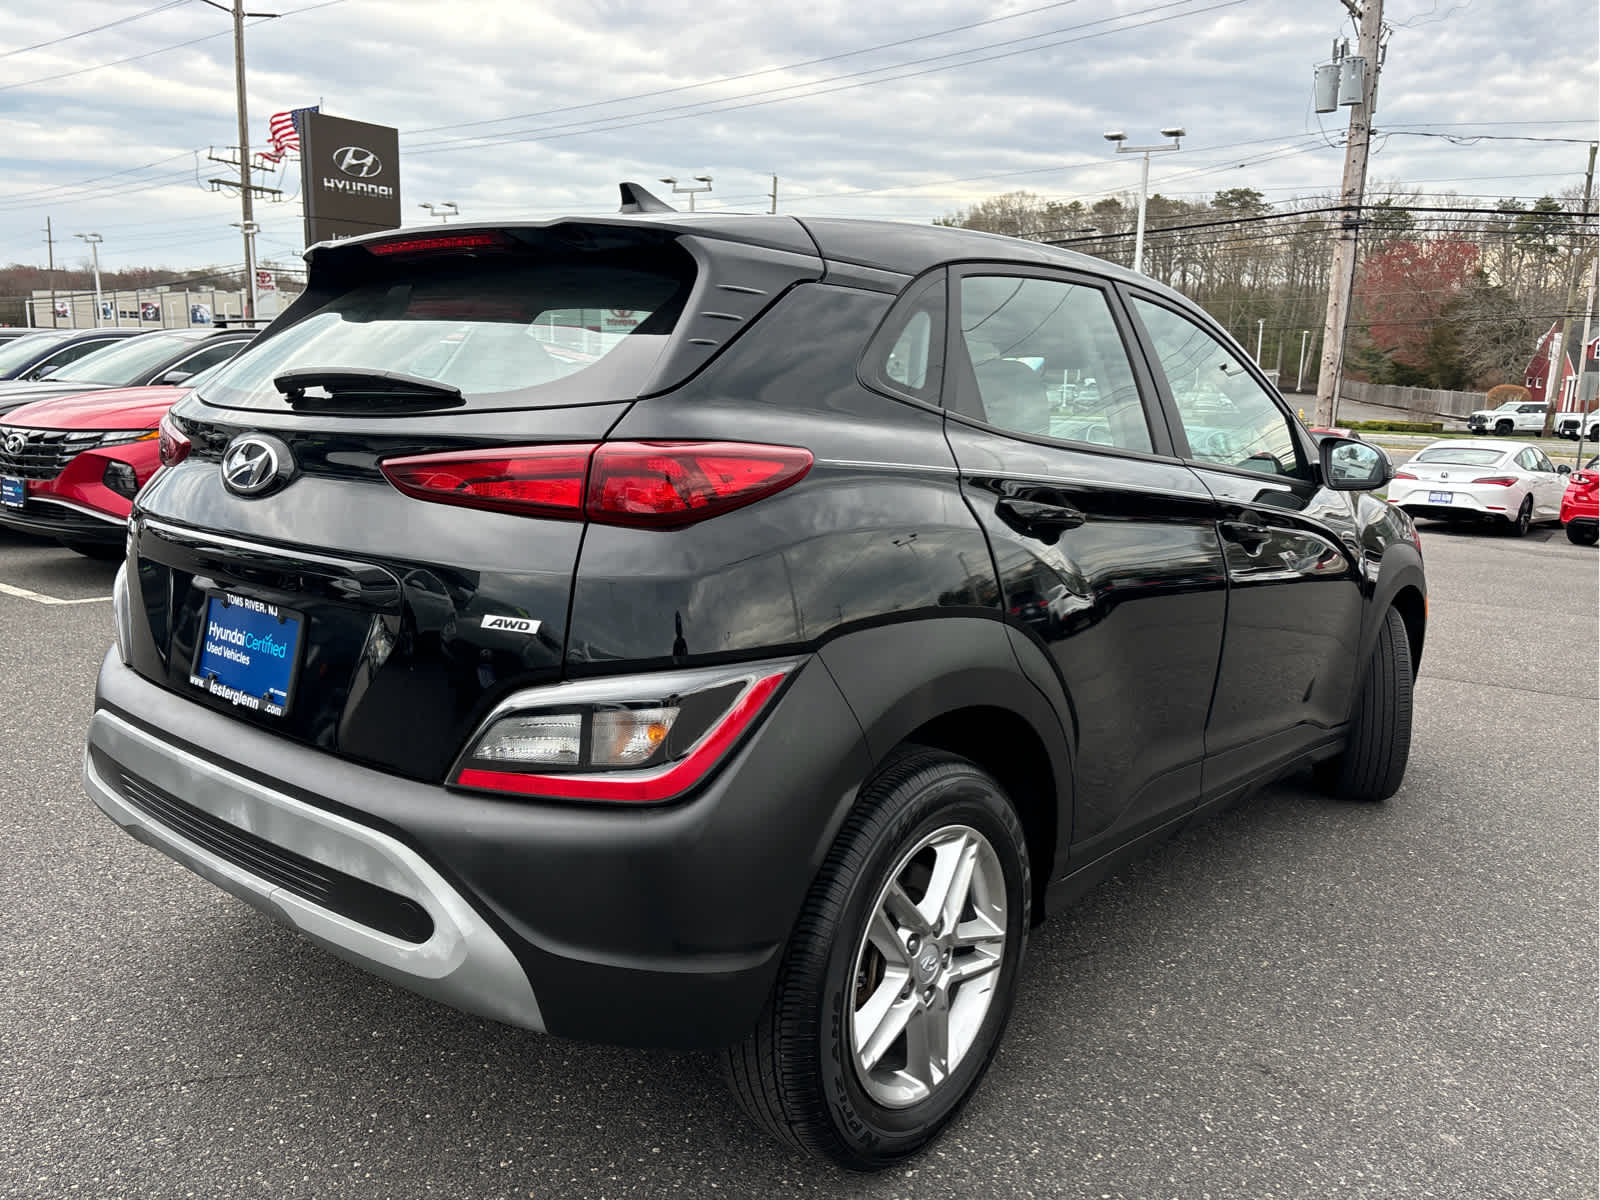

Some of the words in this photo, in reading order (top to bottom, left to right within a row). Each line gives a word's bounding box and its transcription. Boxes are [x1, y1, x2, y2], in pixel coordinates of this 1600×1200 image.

[323, 177, 393, 199] HYUNDAI
[226, 593, 243, 607] TOMS
[244, 598, 267, 614] RIVER,
[268, 605, 278, 617] NJ
[208, 620, 246, 647] Hyundai
[487, 618, 530, 631] AWD
[206, 640, 223, 656] Used
[222, 644, 250, 666] Vehicles
[209, 680, 259, 709] lesterglenn
